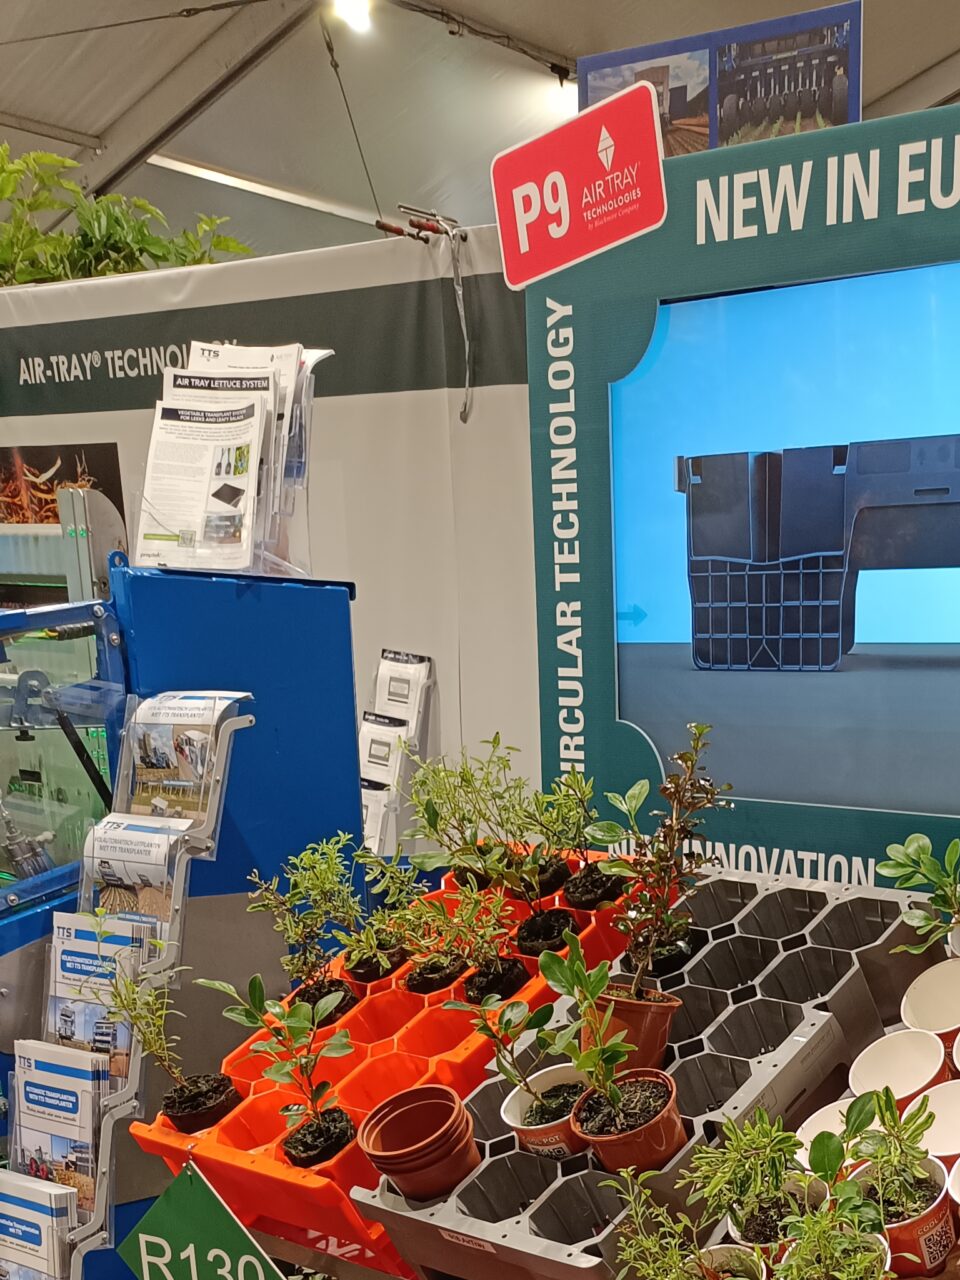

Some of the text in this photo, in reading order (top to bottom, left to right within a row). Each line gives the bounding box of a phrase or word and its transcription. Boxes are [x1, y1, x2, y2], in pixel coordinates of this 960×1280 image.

[583, 187, 642, 222] TECHNOLOGIES
[696, 160, 813, 246] NEW
[826, 149, 880, 226] IN
[512, 170, 570, 254] P9
[200, 348, 220, 358] TTS
[176, 377, 268, 388] AIR TRAY LETTUCE SYSTEM
[545, 296, 586, 792] IRCULAR TECHNOLOGY
[103, 820, 122, 830] TTS
[683, 838, 876, 888] INNOVATION
[56, 925, 72, 938] TTS
[18, 1055, 32, 1068] TTS
[917, 1220, 938, 1235] COOL
